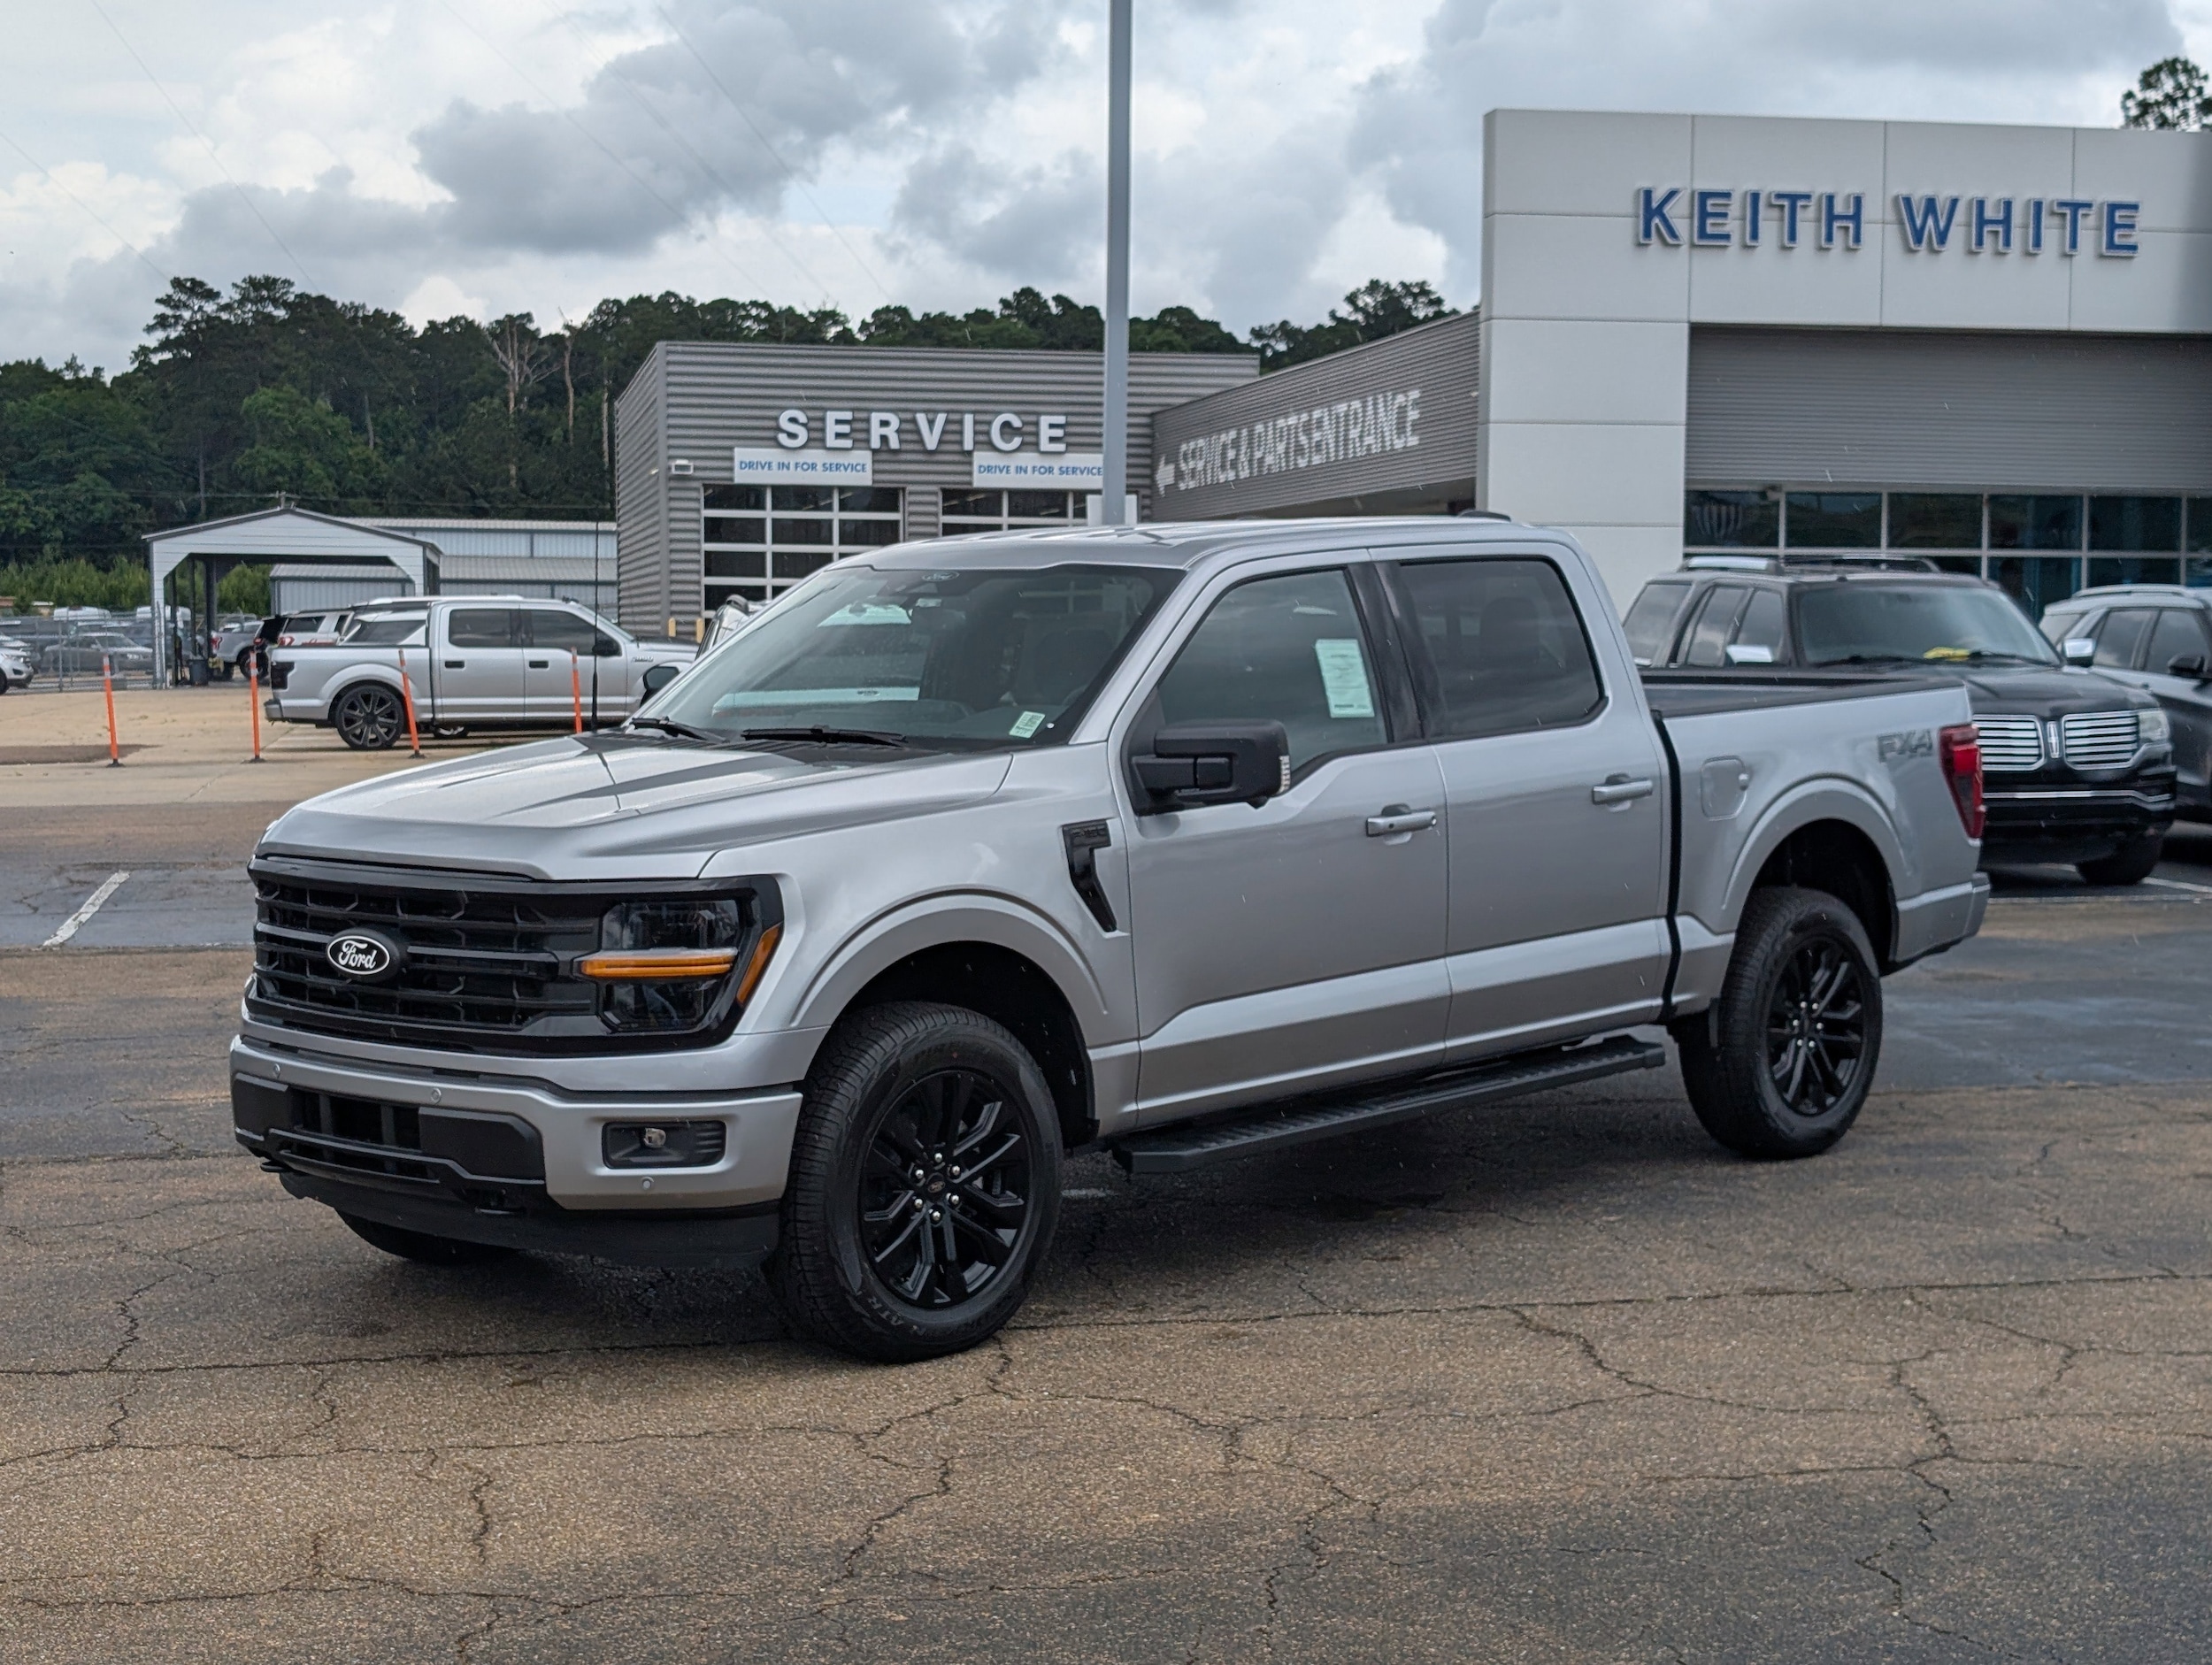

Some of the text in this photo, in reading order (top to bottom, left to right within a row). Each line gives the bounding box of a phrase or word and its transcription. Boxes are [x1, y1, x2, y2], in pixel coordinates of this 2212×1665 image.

[1637, 187, 2141, 257] KEITH WHITE
[777, 409, 1067, 452] SERVICE
[739, 460, 867, 472] DRIVE IN FOR SERVICE
[978, 464, 1102, 476] DRIVE IN FOR SERVICE
[338, 940, 377, 969] Ford
